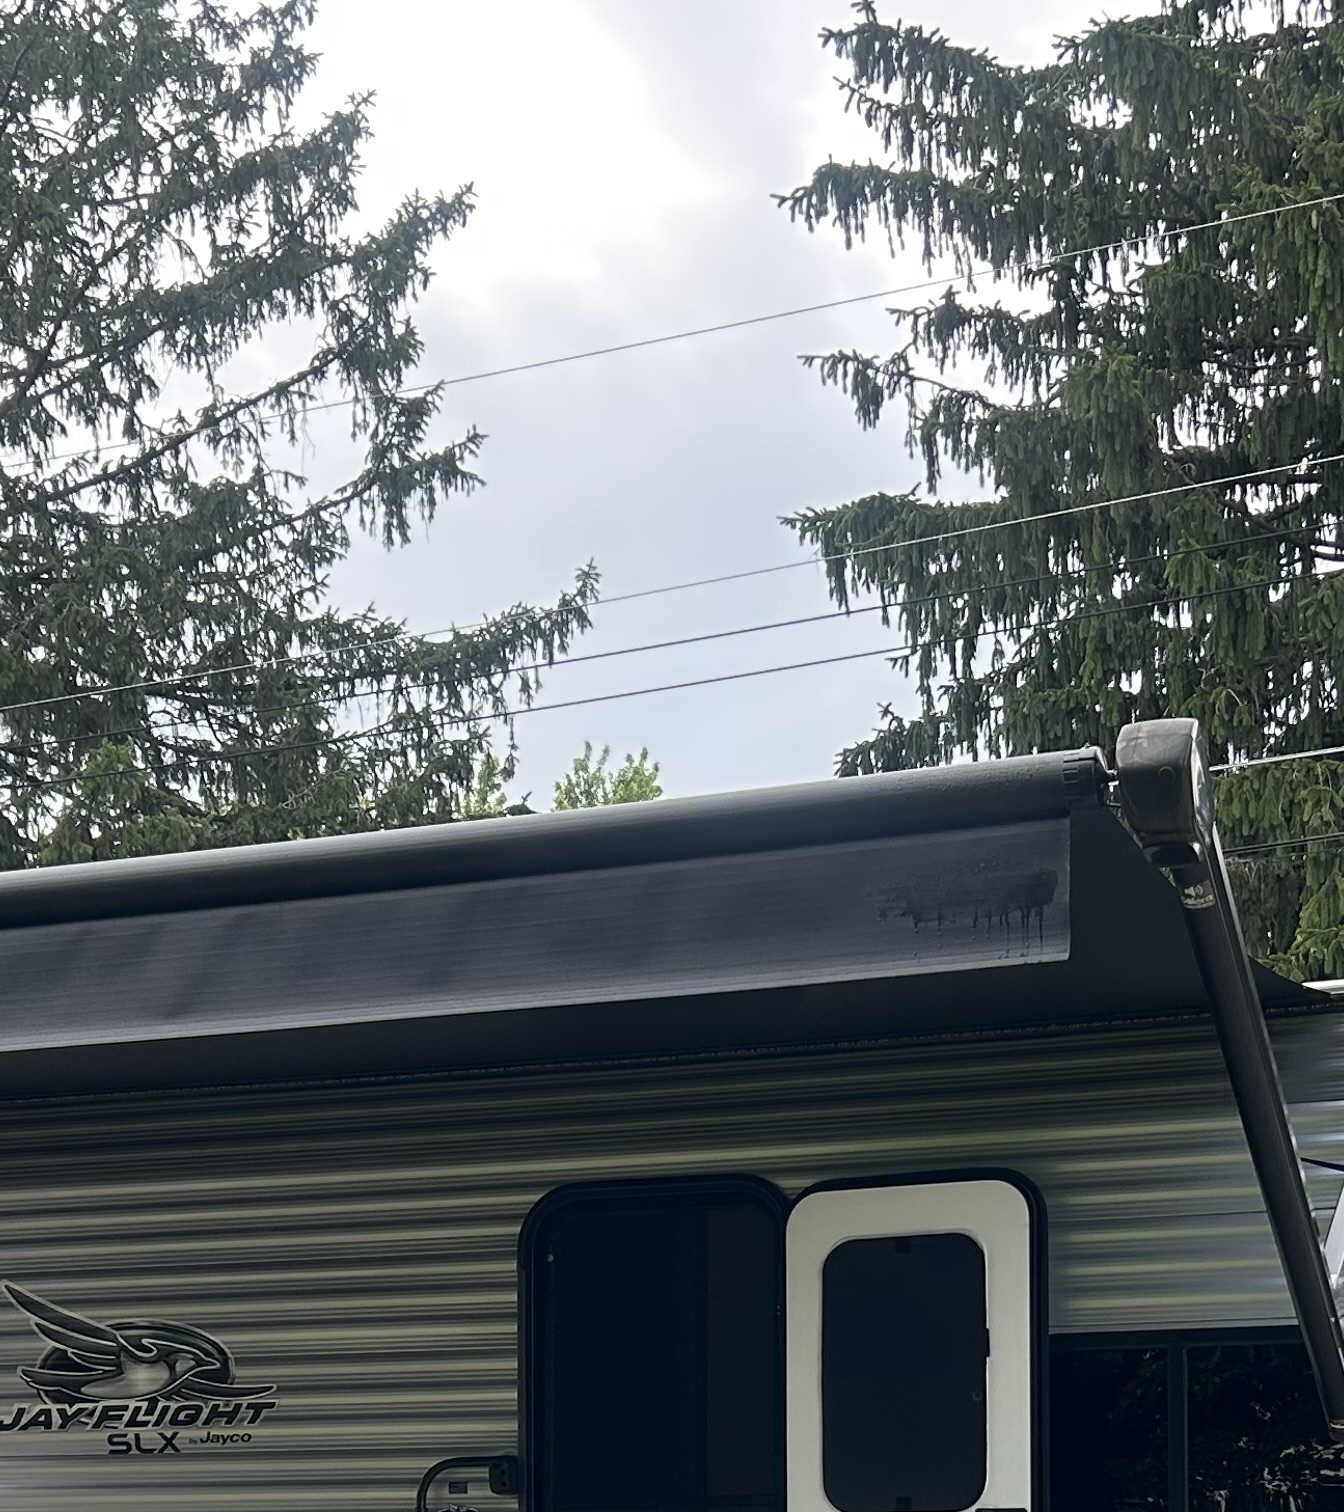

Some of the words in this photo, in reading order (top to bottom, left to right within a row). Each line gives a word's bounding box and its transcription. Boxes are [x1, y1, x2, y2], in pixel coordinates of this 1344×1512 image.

[90, 1400, 277, 1430] FLIGHT
[106, 1431, 181, 1454] SLX
[199, 1430, 252, 1446] Jayco
